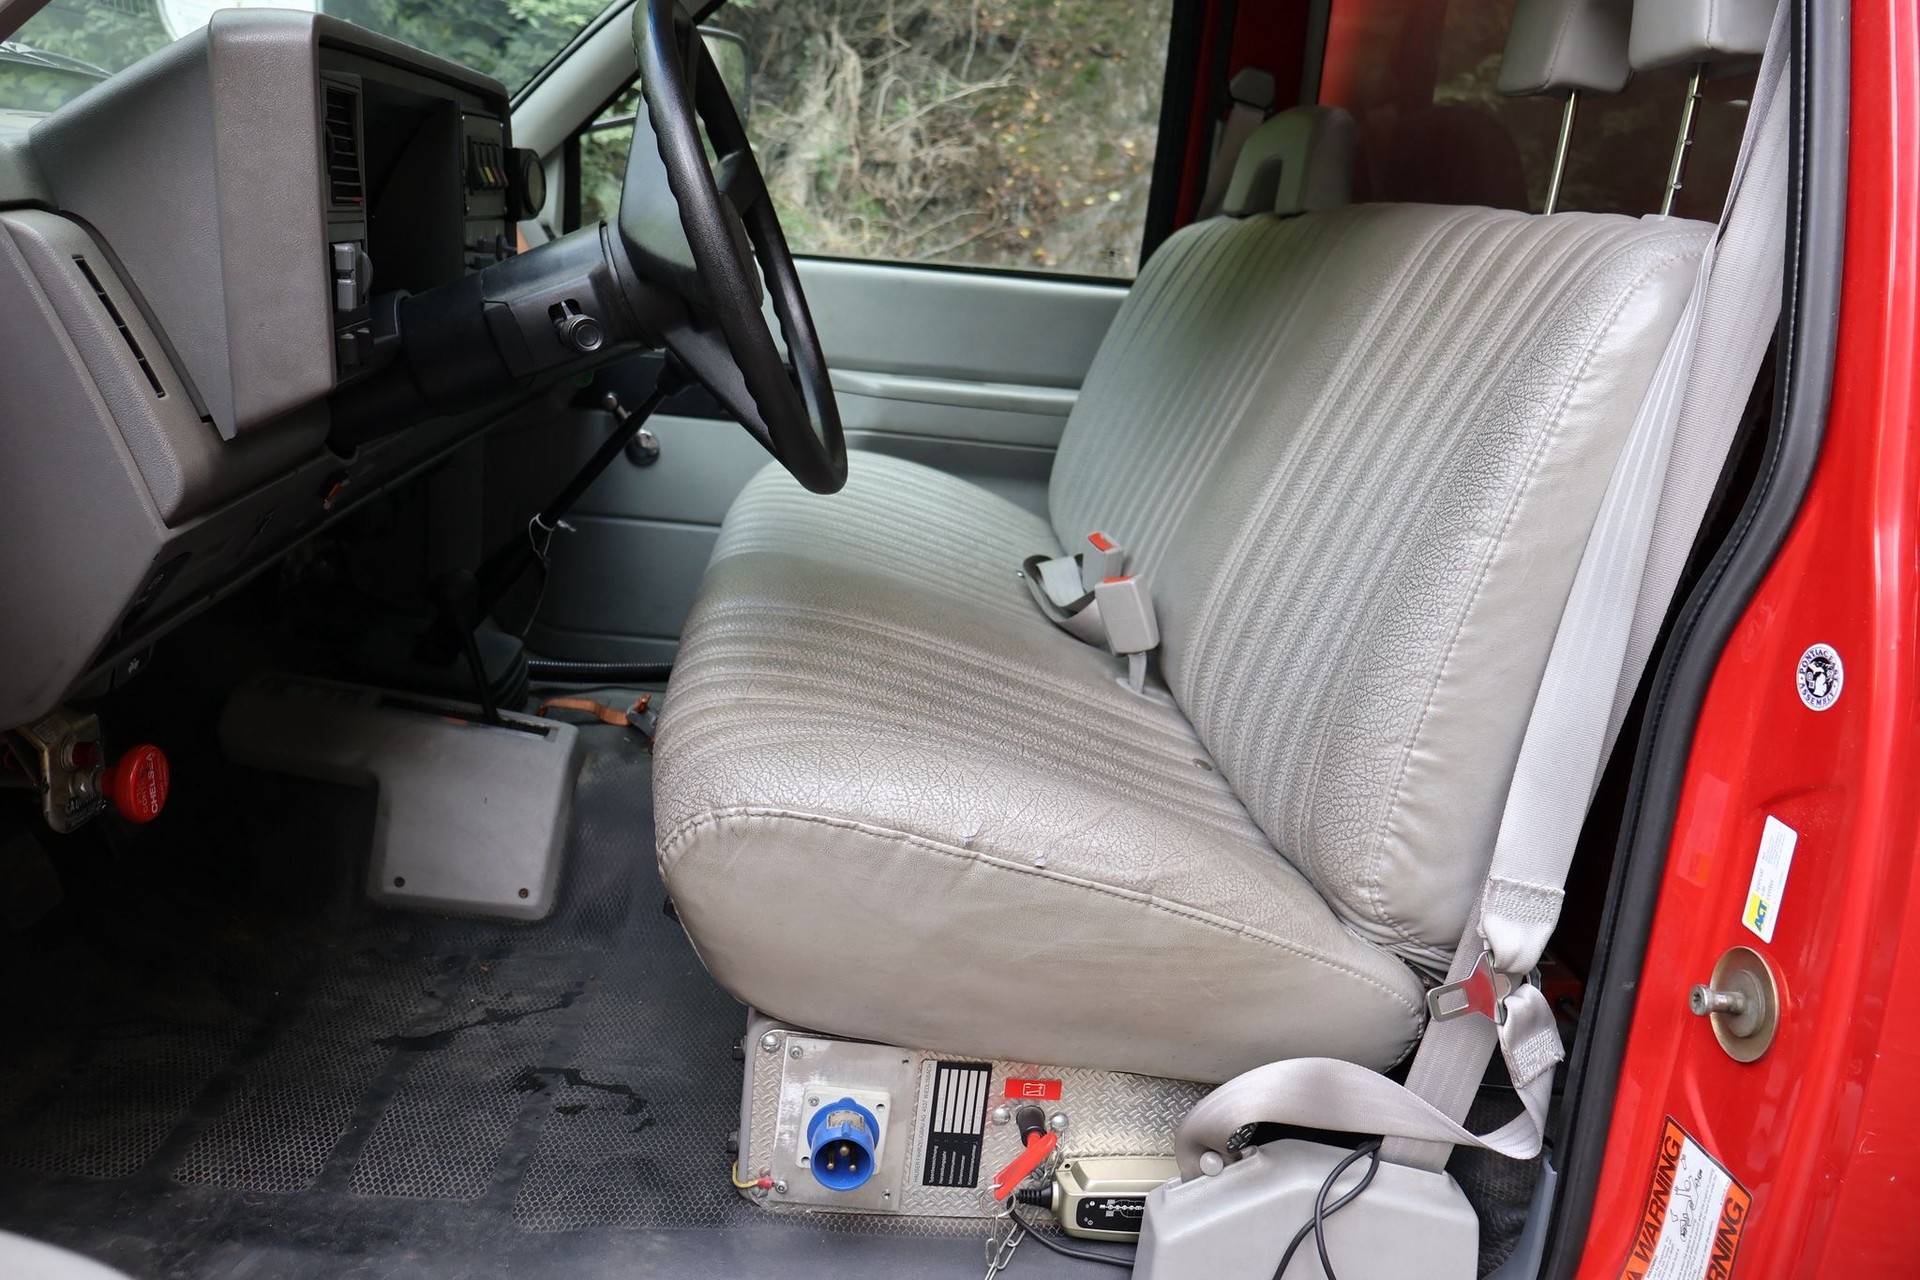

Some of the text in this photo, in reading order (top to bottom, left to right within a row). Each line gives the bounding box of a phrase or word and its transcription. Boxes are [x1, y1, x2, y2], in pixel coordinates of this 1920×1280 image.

[1799, 649, 1828, 675] PONTIAC
[1798, 682, 1834, 706] ASSEMBLY
[147, 752, 159, 814] CHELSEA
[1754, 899, 1766, 932] ACT
[1635, 1136, 1681, 1263] WARNING
